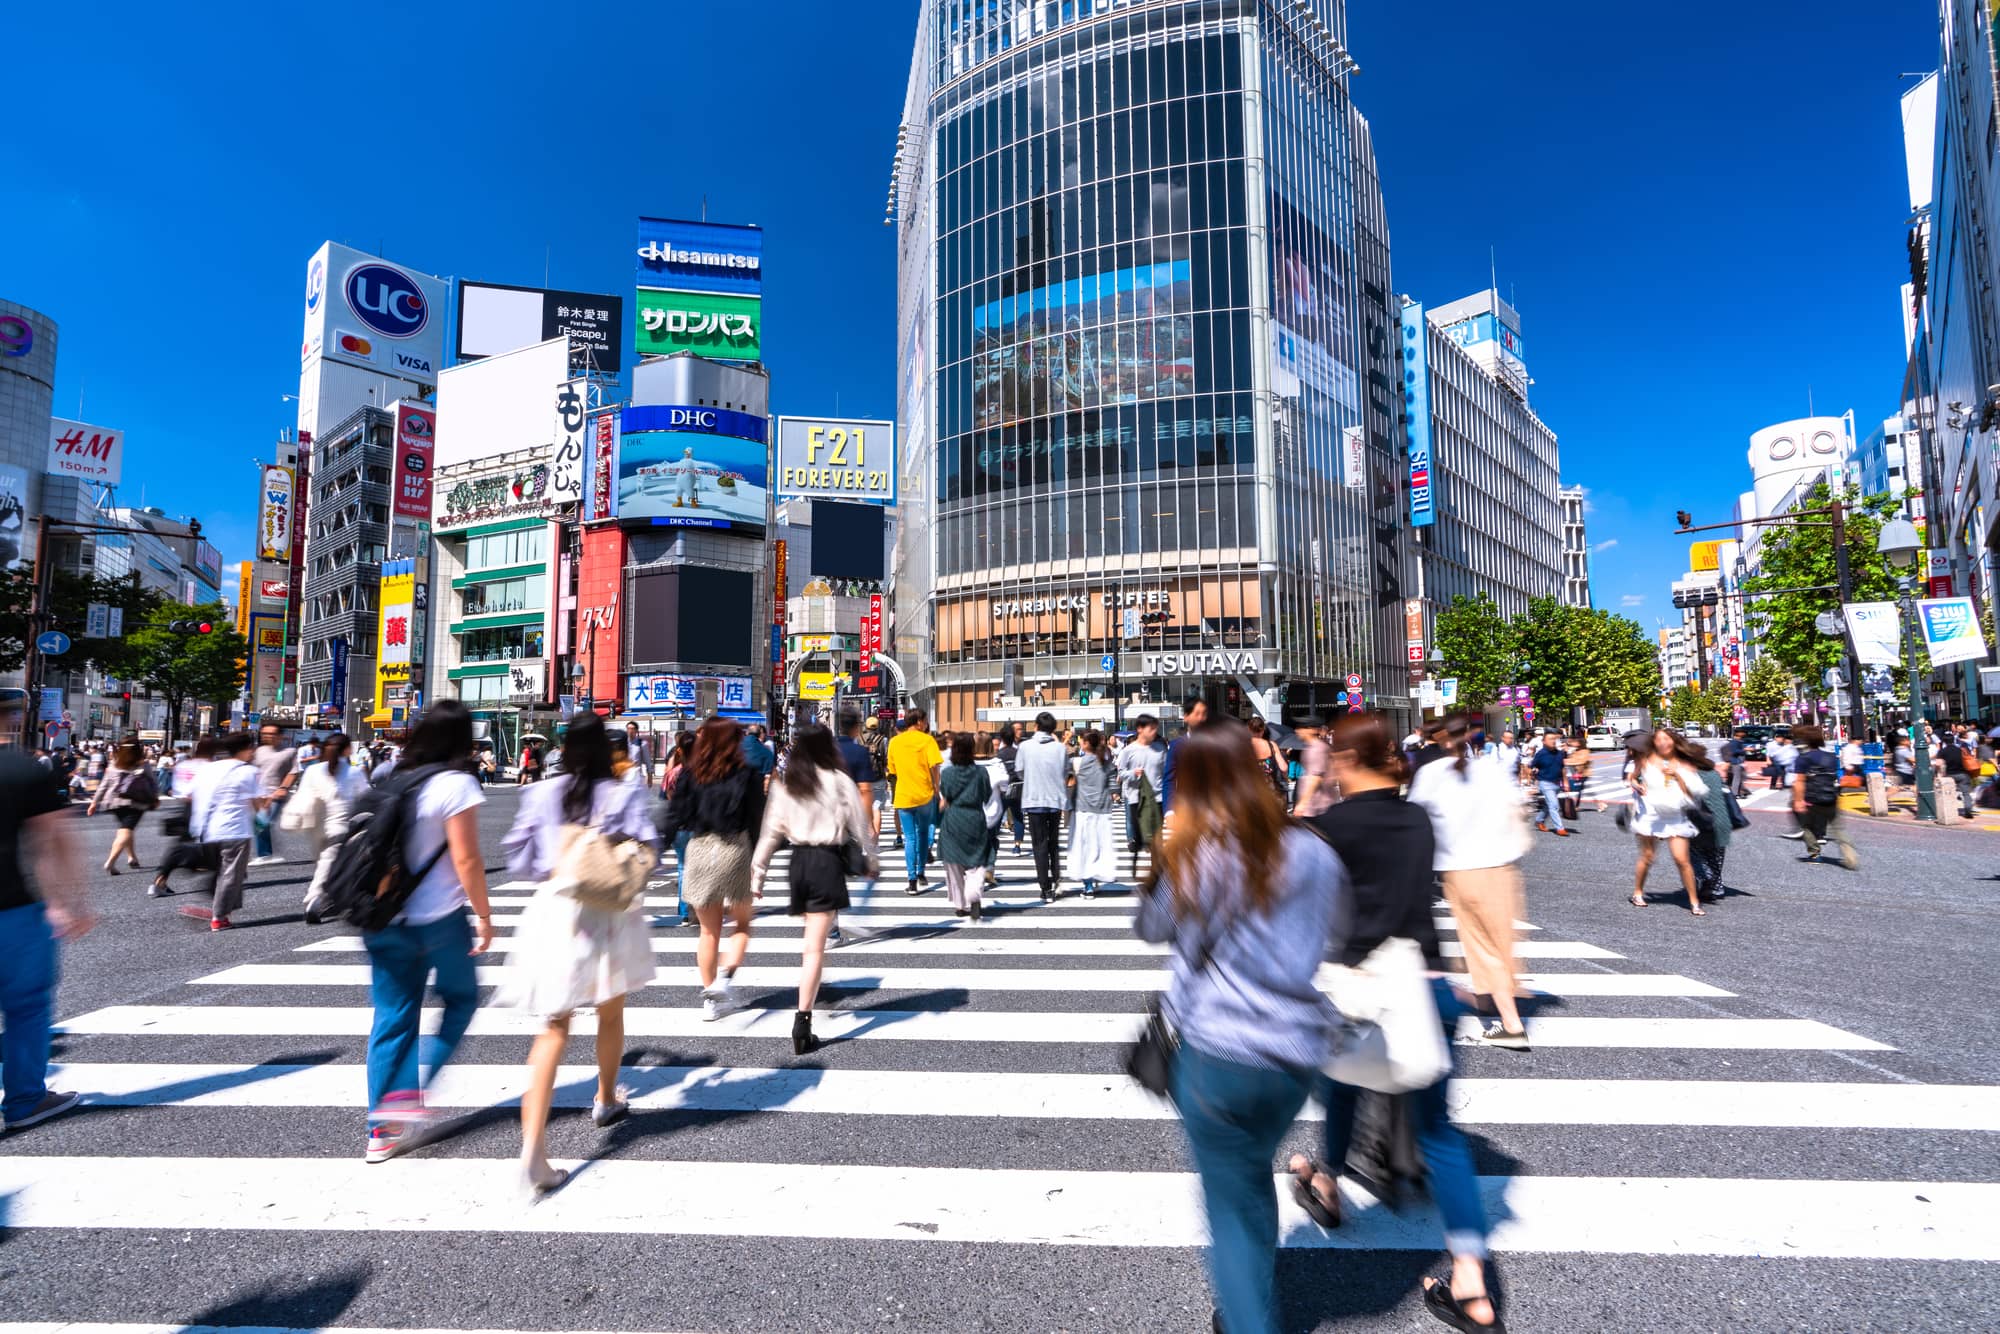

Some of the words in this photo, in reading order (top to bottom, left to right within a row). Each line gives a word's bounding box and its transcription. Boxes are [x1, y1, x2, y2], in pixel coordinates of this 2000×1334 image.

[637, 240, 759, 269] Hisamitsu
[356, 275, 420, 323] UC
[557, 306, 609, 321] 鈴木愛理
[641, 307, 757, 337] サロンパス
[395, 353, 431, 373] VISA
[670, 409, 716, 427] DHC
[54, 428, 115, 462] H&M
[554, 383, 583, 498] もんじゃ
[627, 439, 644, 447] DHC
[806, 426, 866, 467] F21
[785, 467, 866, 490] FOREVER
[868, 471, 888, 490] 21
[993, 595, 1090, 616] STARBUCKS
[385, 615, 407, 646] 薬
[580, 591, 619, 654] クスリ
[1147, 653, 1258, 673] TSUTAYA
[634, 681, 744, 701] 大盛堂店
